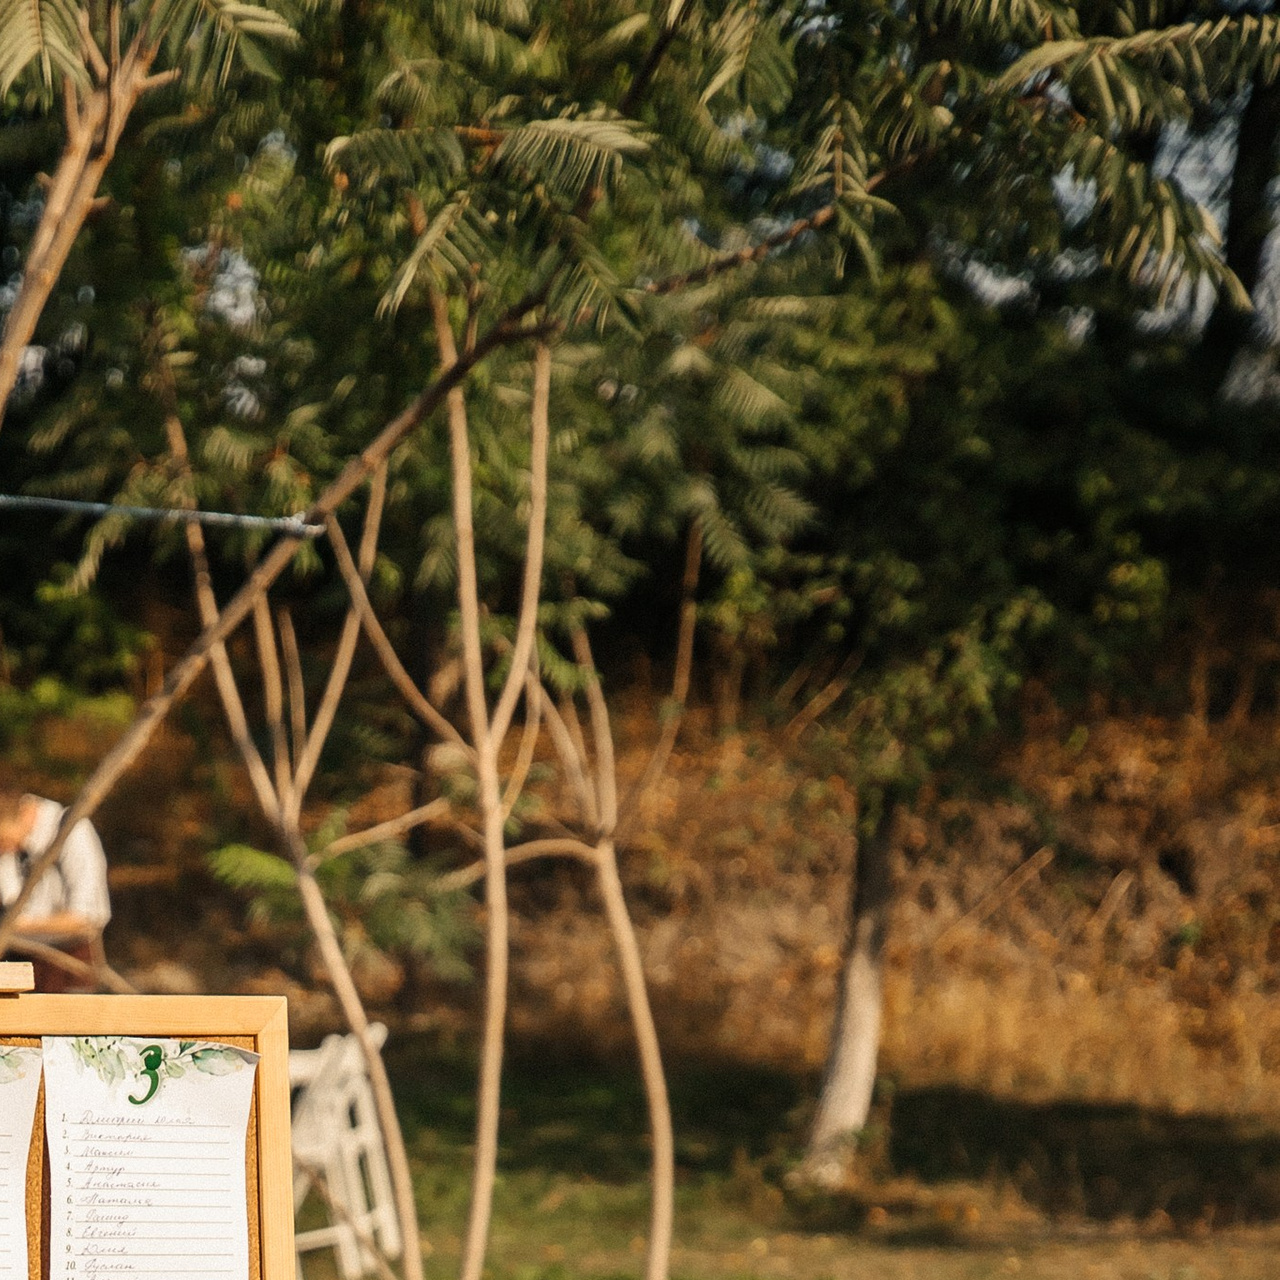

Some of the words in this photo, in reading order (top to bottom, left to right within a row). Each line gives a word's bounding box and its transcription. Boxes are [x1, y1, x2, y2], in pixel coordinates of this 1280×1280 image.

[128, 1044, 163, 1105] 3
[62, 1113, 70, 1122] 1.
[62, 1130, 70, 1139] 2.
[64, 1146, 72, 1155] 3.
[66, 1163, 74, 1172] 4.
[67, 1178, 75, 1187] 5.
[67, 1195, 75, 1204] 6.
[67, 1211, 75, 1220] 7.
[66, 1228, 74, 1237] 8.
[66, 1245, 74, 1254] 9.
[66, 1261, 77, 1270] 10.
